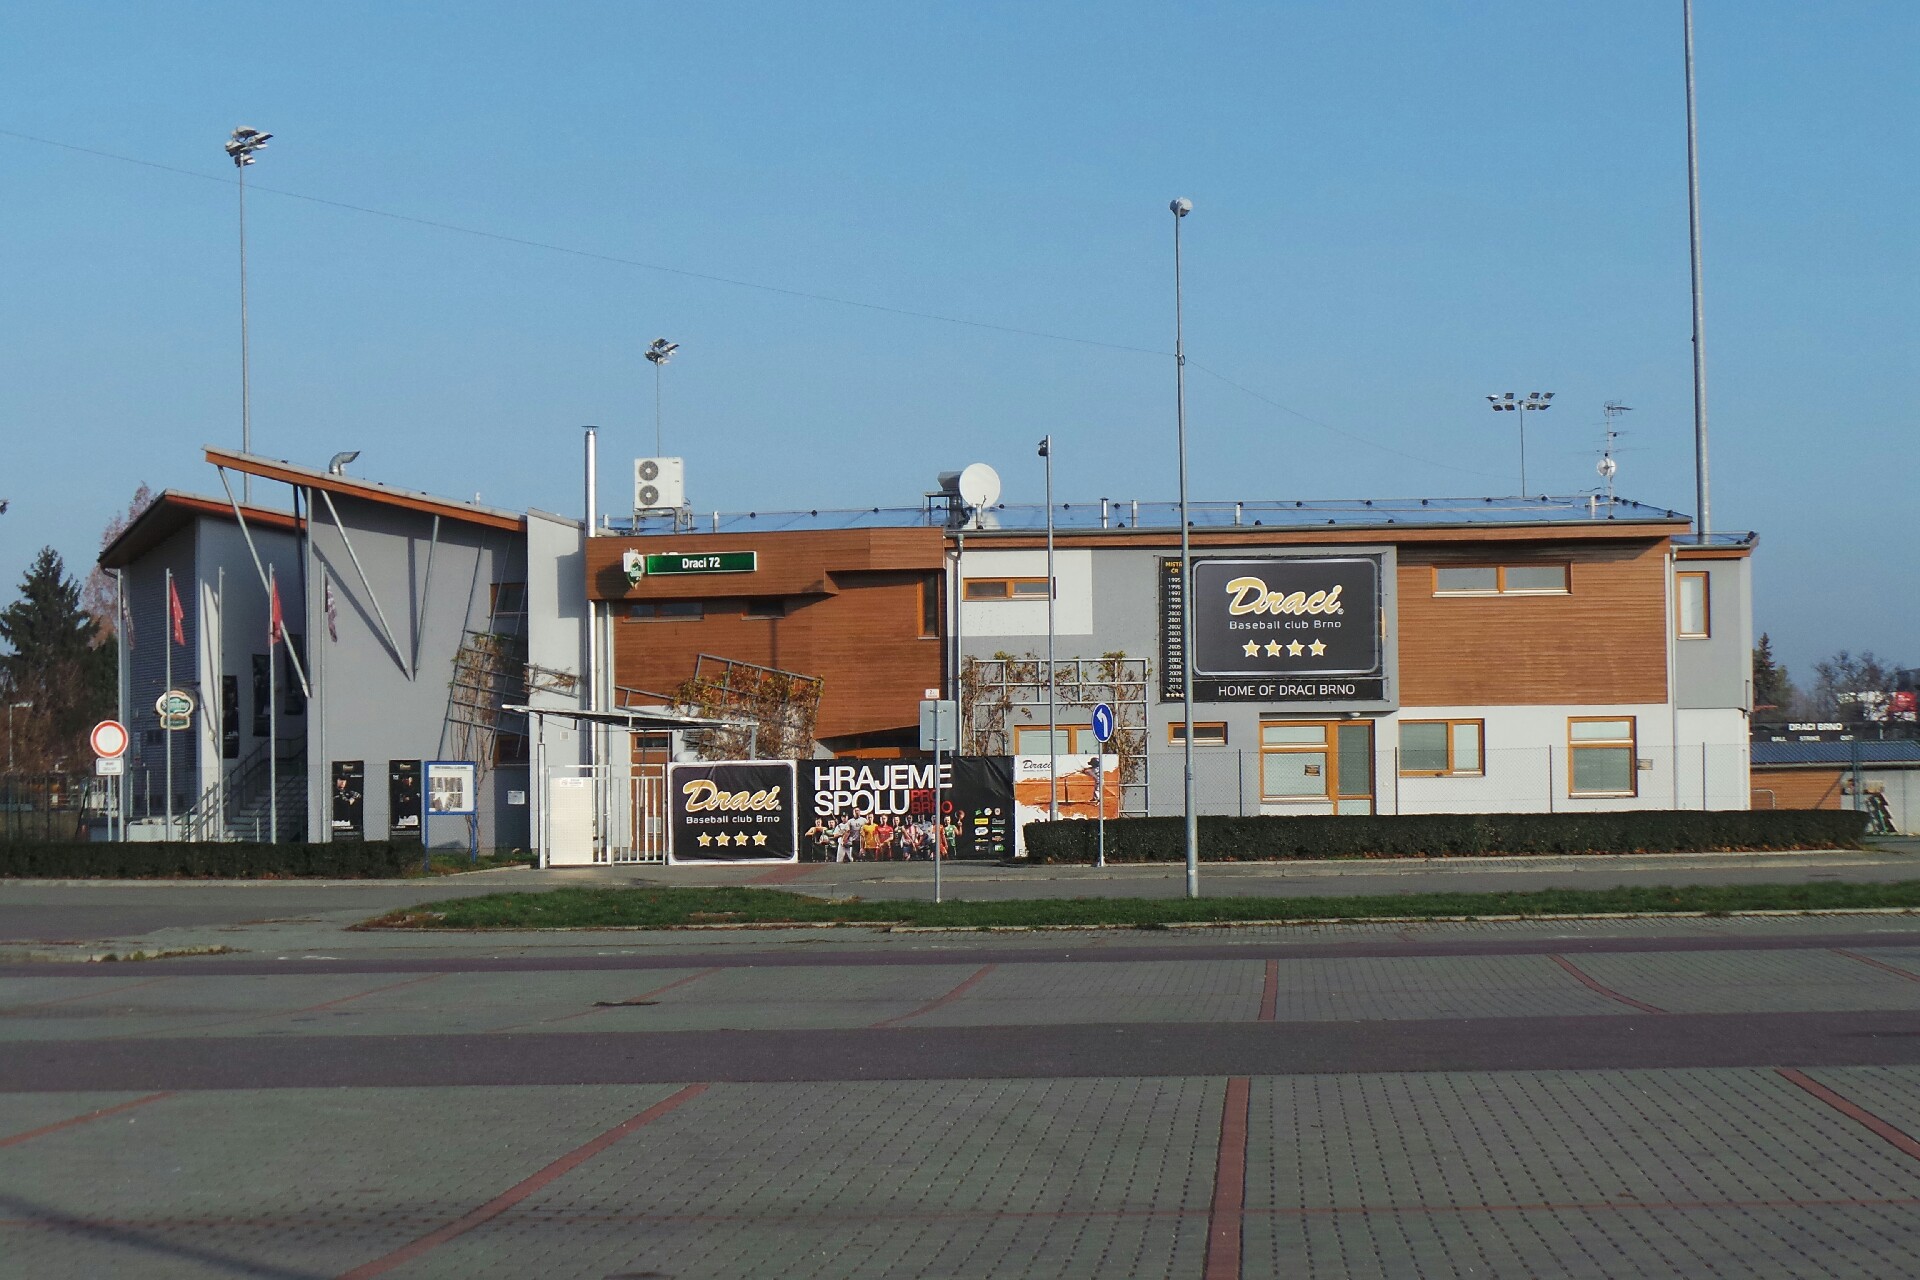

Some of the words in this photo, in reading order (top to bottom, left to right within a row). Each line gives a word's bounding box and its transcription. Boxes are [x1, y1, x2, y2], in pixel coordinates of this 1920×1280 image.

[682, 557, 706, 569] Draci
[709, 557, 720, 568] 72
[1226, 576, 1342, 616] Draci
[1229, 620, 1280, 630] Baseball
[1285, 620, 1309, 629] club
[1314, 619, 1341, 628] Brno
[1218, 685, 1255, 696] HOME
[1259, 684, 1276, 696] OF
[1279, 684, 1316, 696] DRACI
[1319, 684, 1356, 695] BRNO
[1788, 723, 1816, 731] DRACI
[1817, 722, 1843, 731] BRNO
[814, 764, 953, 791] HRAJEME
[683, 779, 781, 812] Draci
[814, 790, 910, 816] SPOLU
[686, 816, 728, 824] Baseball
[732, 815, 752, 823] club
[756, 815, 780, 823] Brno
